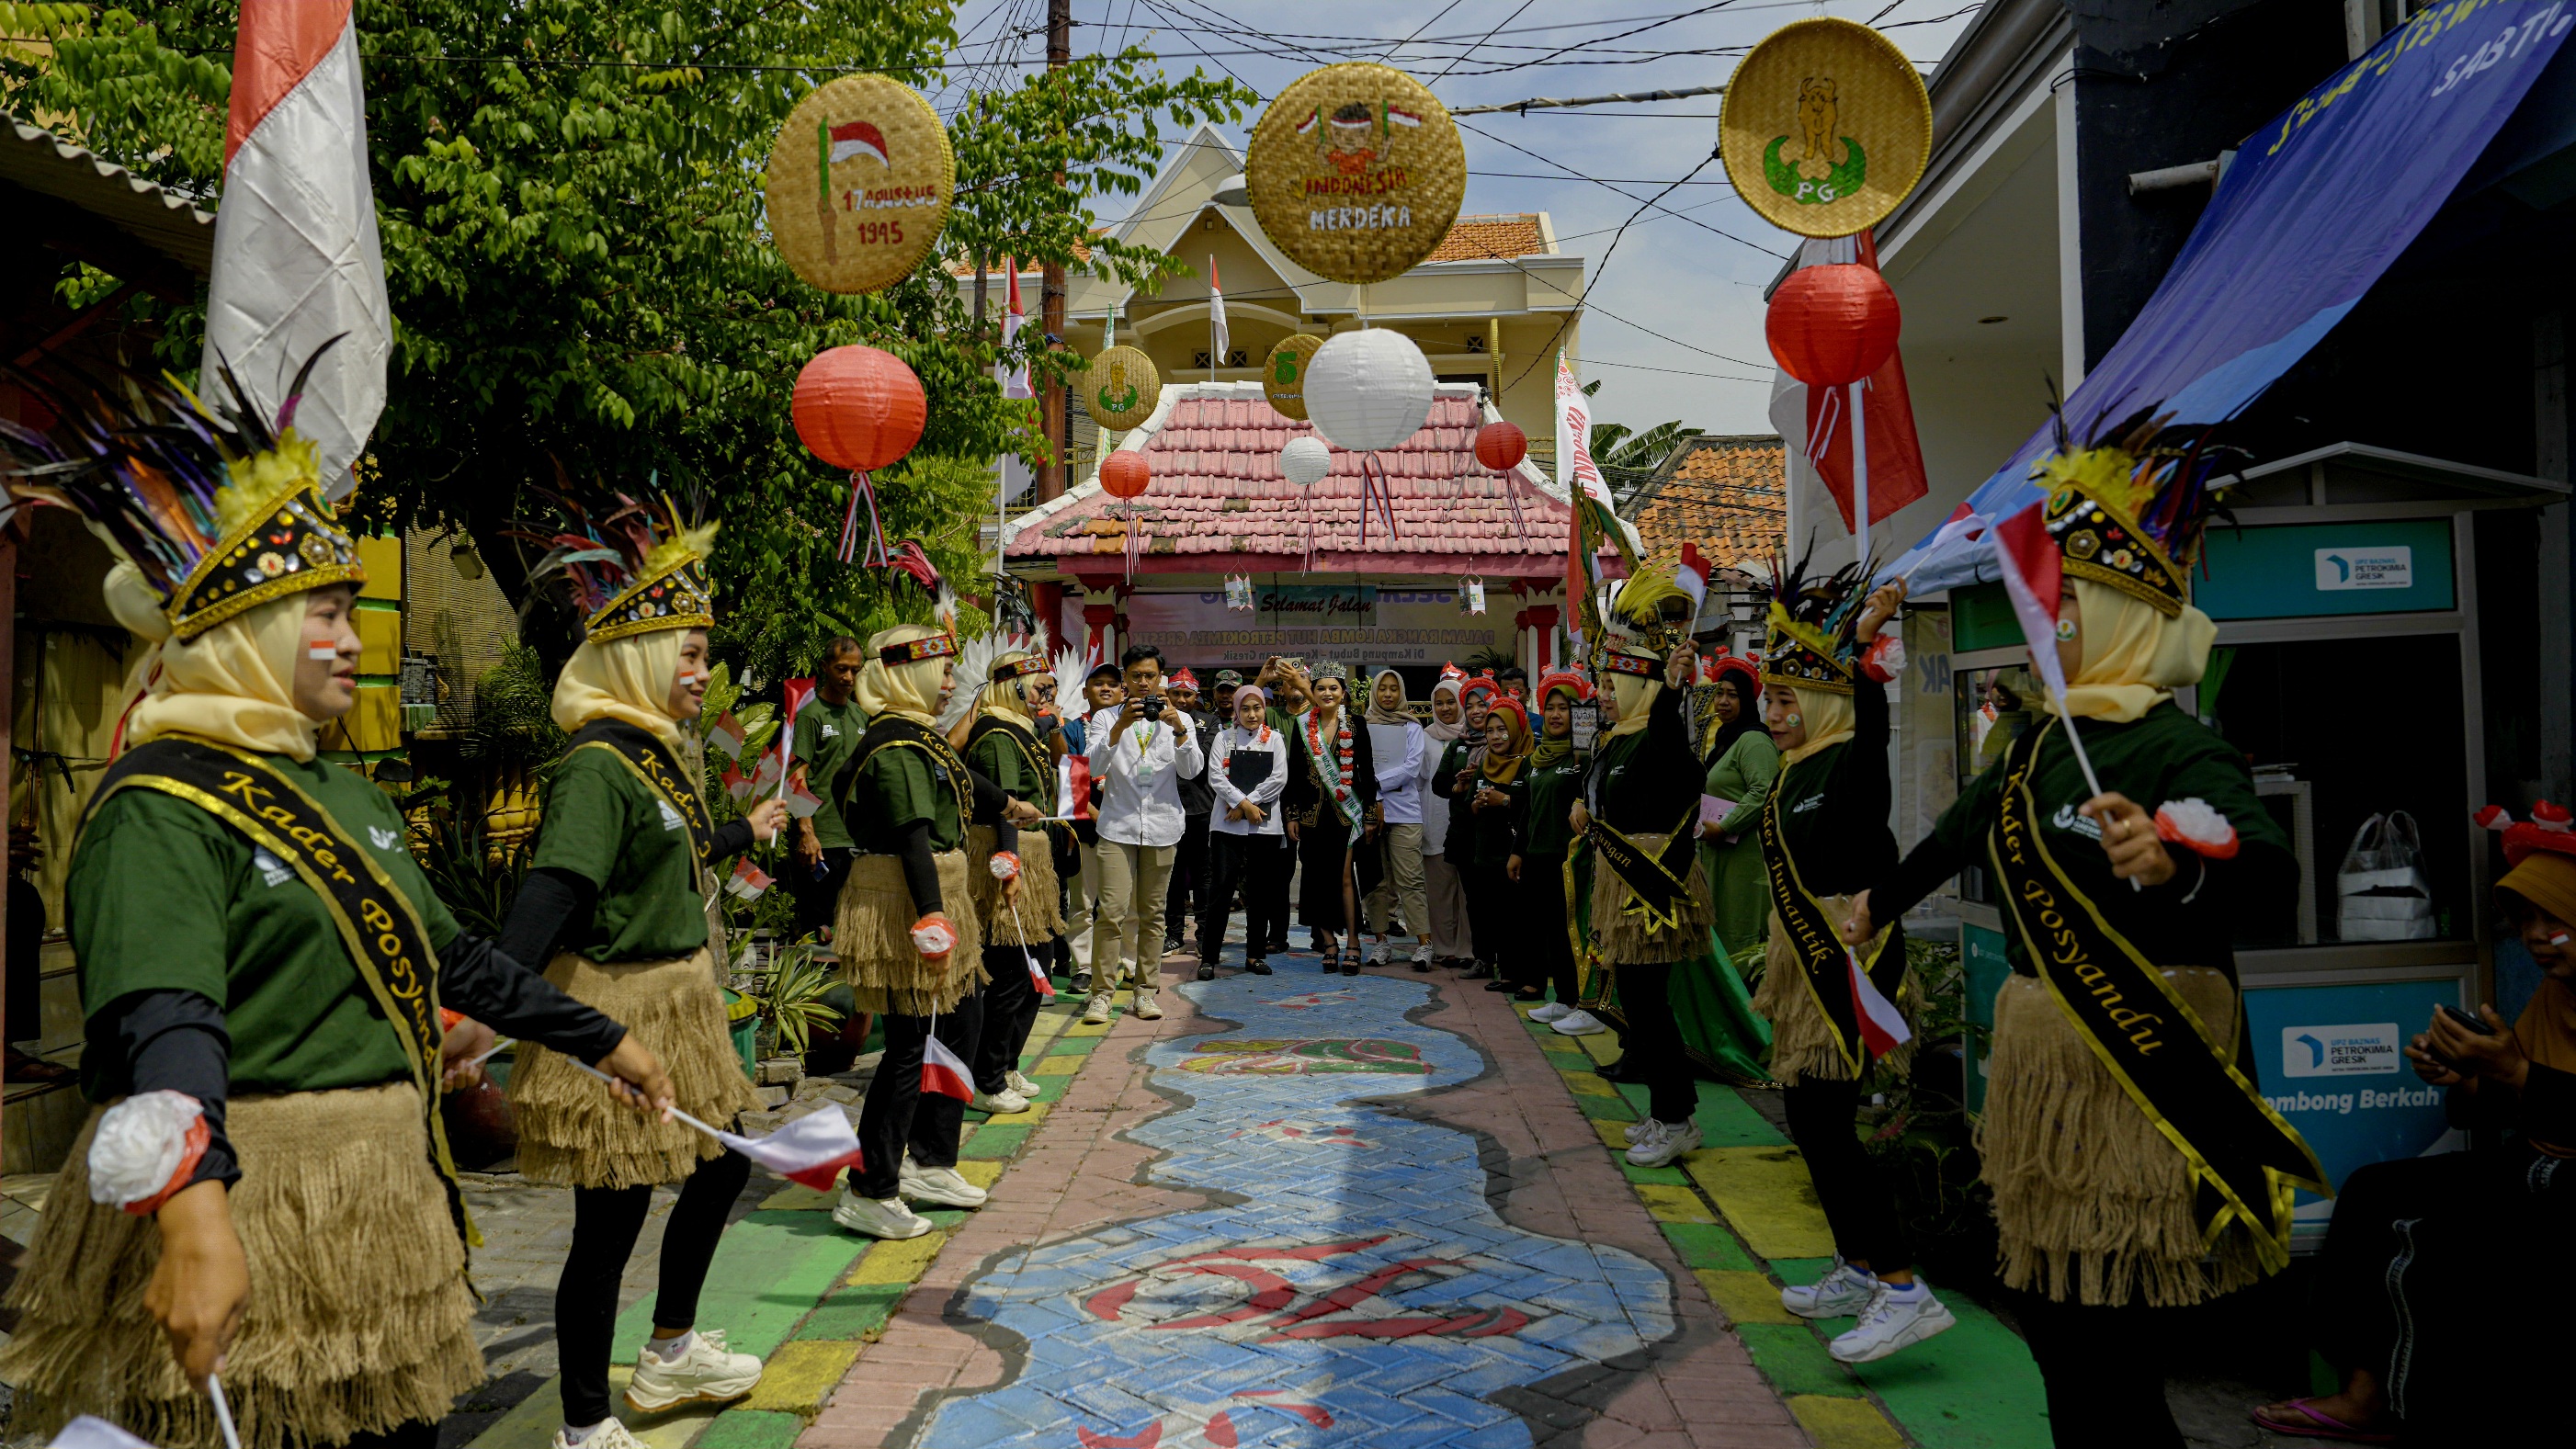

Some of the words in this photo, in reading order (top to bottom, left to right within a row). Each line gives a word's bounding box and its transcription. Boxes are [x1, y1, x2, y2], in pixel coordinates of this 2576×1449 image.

[1305, 167, 1408, 195] INDONESIA
[1794, 181, 1835, 202] PG
[1310, 203, 1411, 231] MERDEKA
[857, 221, 903, 245] 1945
[1111, 403, 1125, 413] PG
[2355, 564, 2407, 572] PETROKIMIA
[1260, 593, 1325, 613] Selamat
[1328, 594, 1372, 617] Jalan
[919, 731, 961, 772] Kader
[641, 748, 702, 829] Kader
[217, 770, 356, 886] Kader
[360, 897, 438, 1069] Posyand
[1771, 855, 1834, 975] Jumantik
[2001, 764, 2027, 866] Kader
[2023, 878, 2163, 1058] Posyandu
[2331, 1046, 2393, 1056] PETROKIMIA
[2348, 1037, 2380, 1046] BAZNAS
[2331, 1056, 2366, 1065] GRESIK
[2264, 1091, 2355, 1115] ombong
[2358, 1086, 2440, 1109] Berkah
